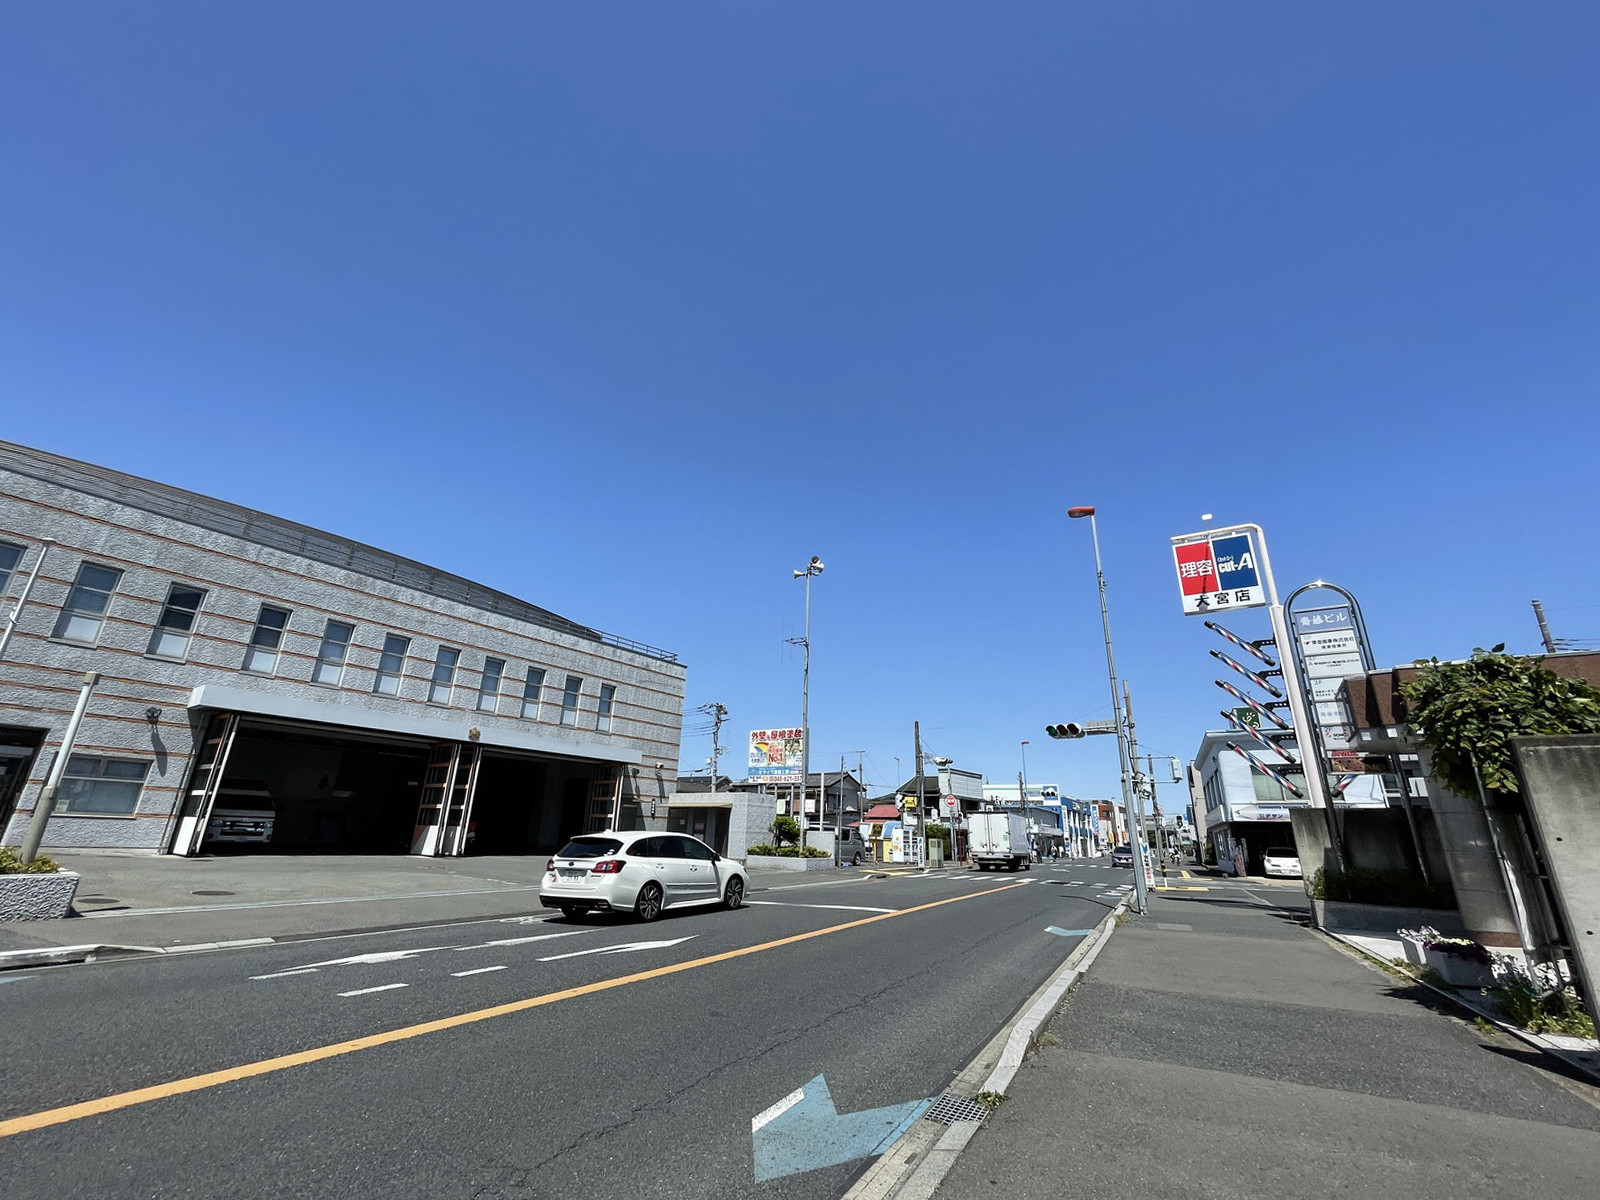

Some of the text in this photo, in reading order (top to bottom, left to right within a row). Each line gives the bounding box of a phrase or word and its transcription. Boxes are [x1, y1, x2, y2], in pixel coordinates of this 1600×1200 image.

[1180, 560, 1213, 578] 理容
[1218, 552, 1253, 572] cut-A
[1194, 590, 1250, 607] 大宮店
